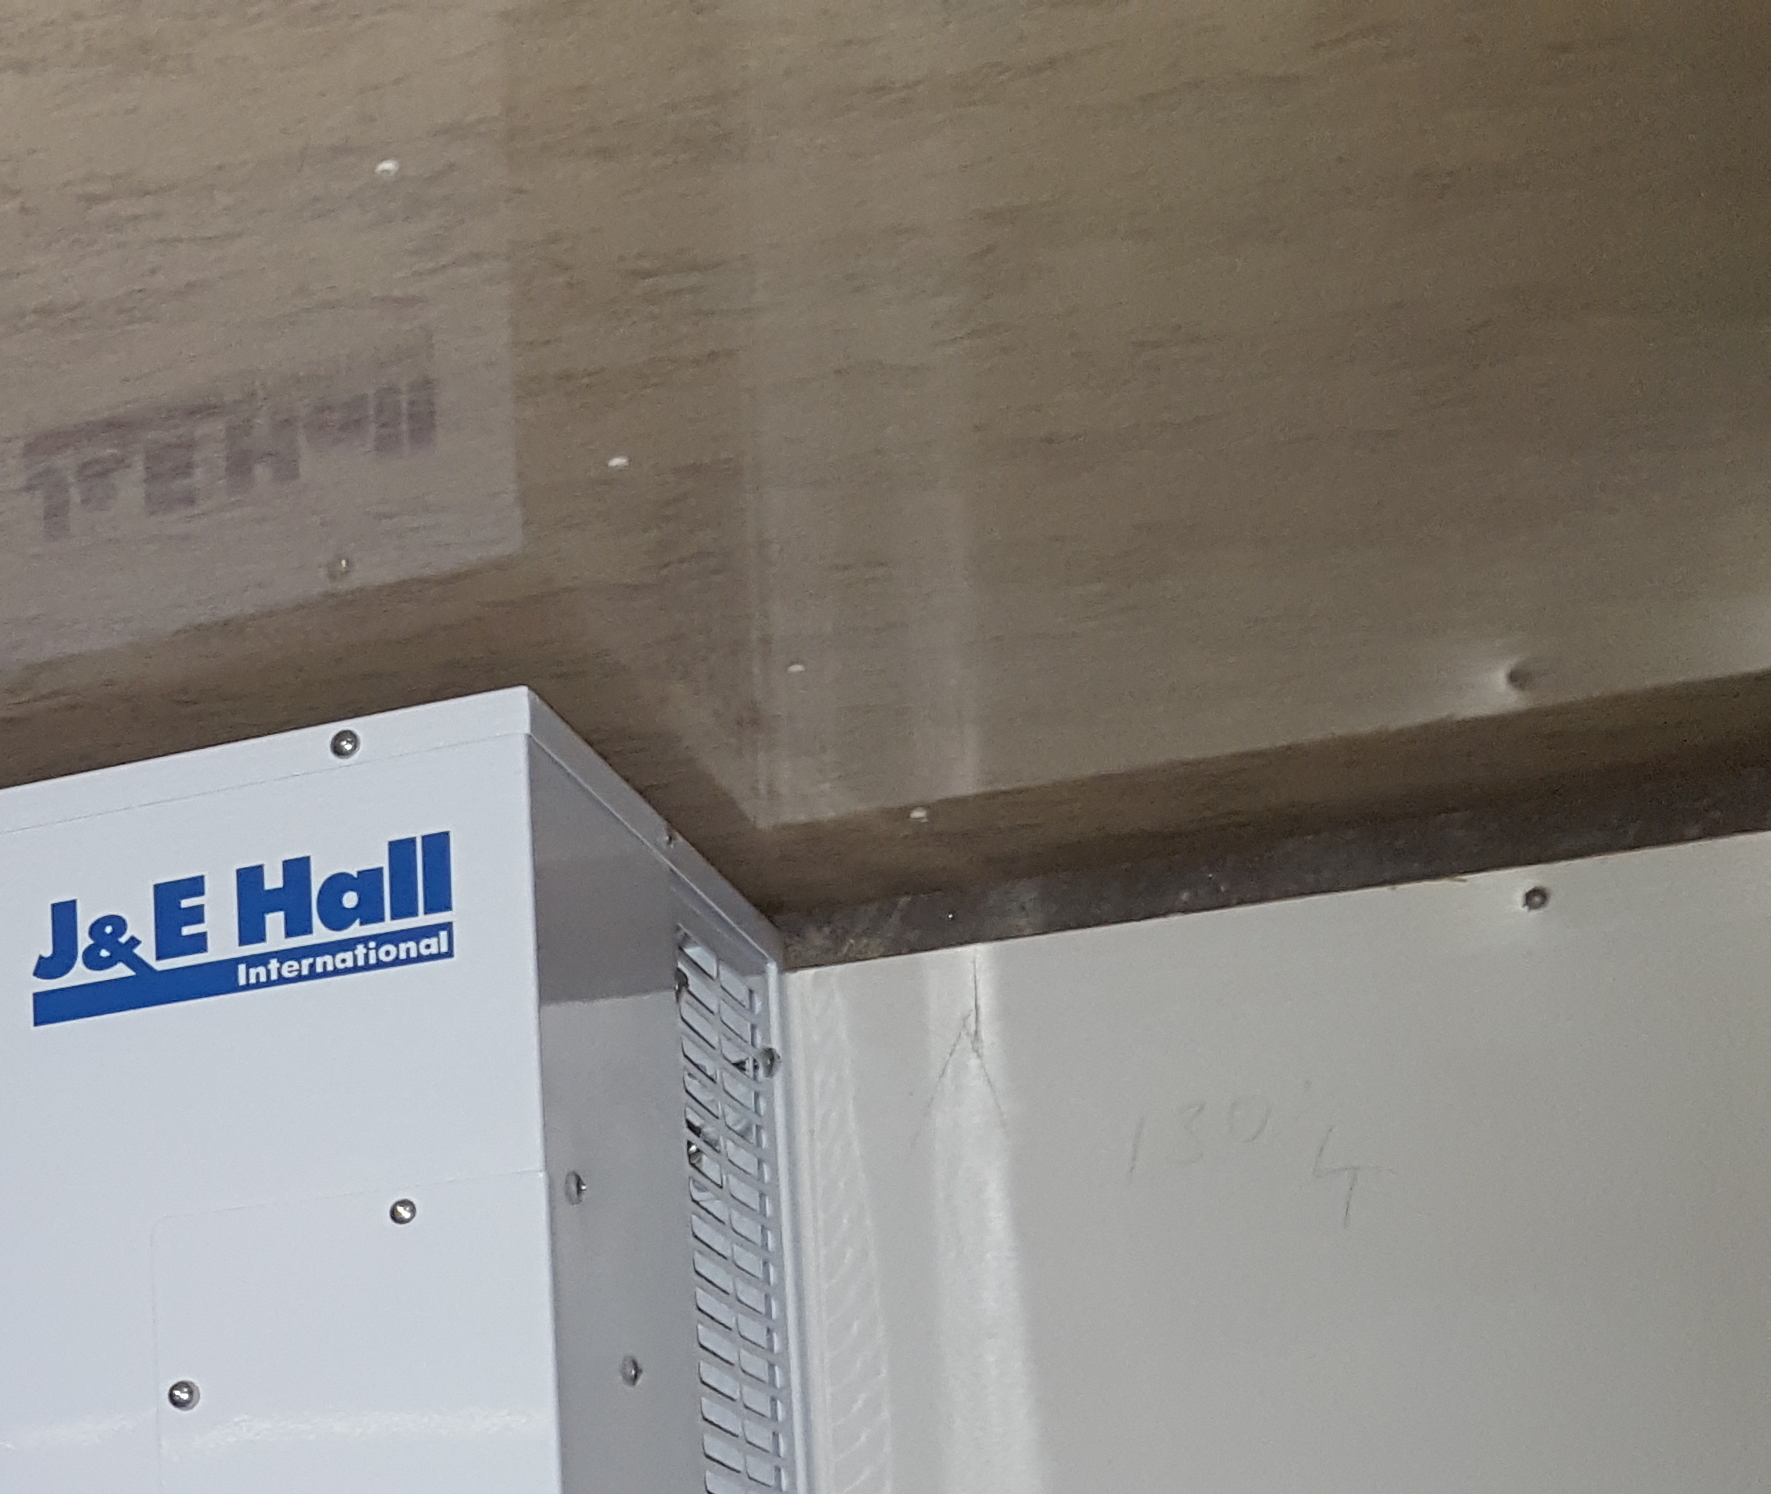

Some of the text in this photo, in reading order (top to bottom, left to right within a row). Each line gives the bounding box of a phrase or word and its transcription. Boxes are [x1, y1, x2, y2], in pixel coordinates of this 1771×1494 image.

[32, 830, 453, 981] J&E Hall
[237, 930, 450, 987] International
